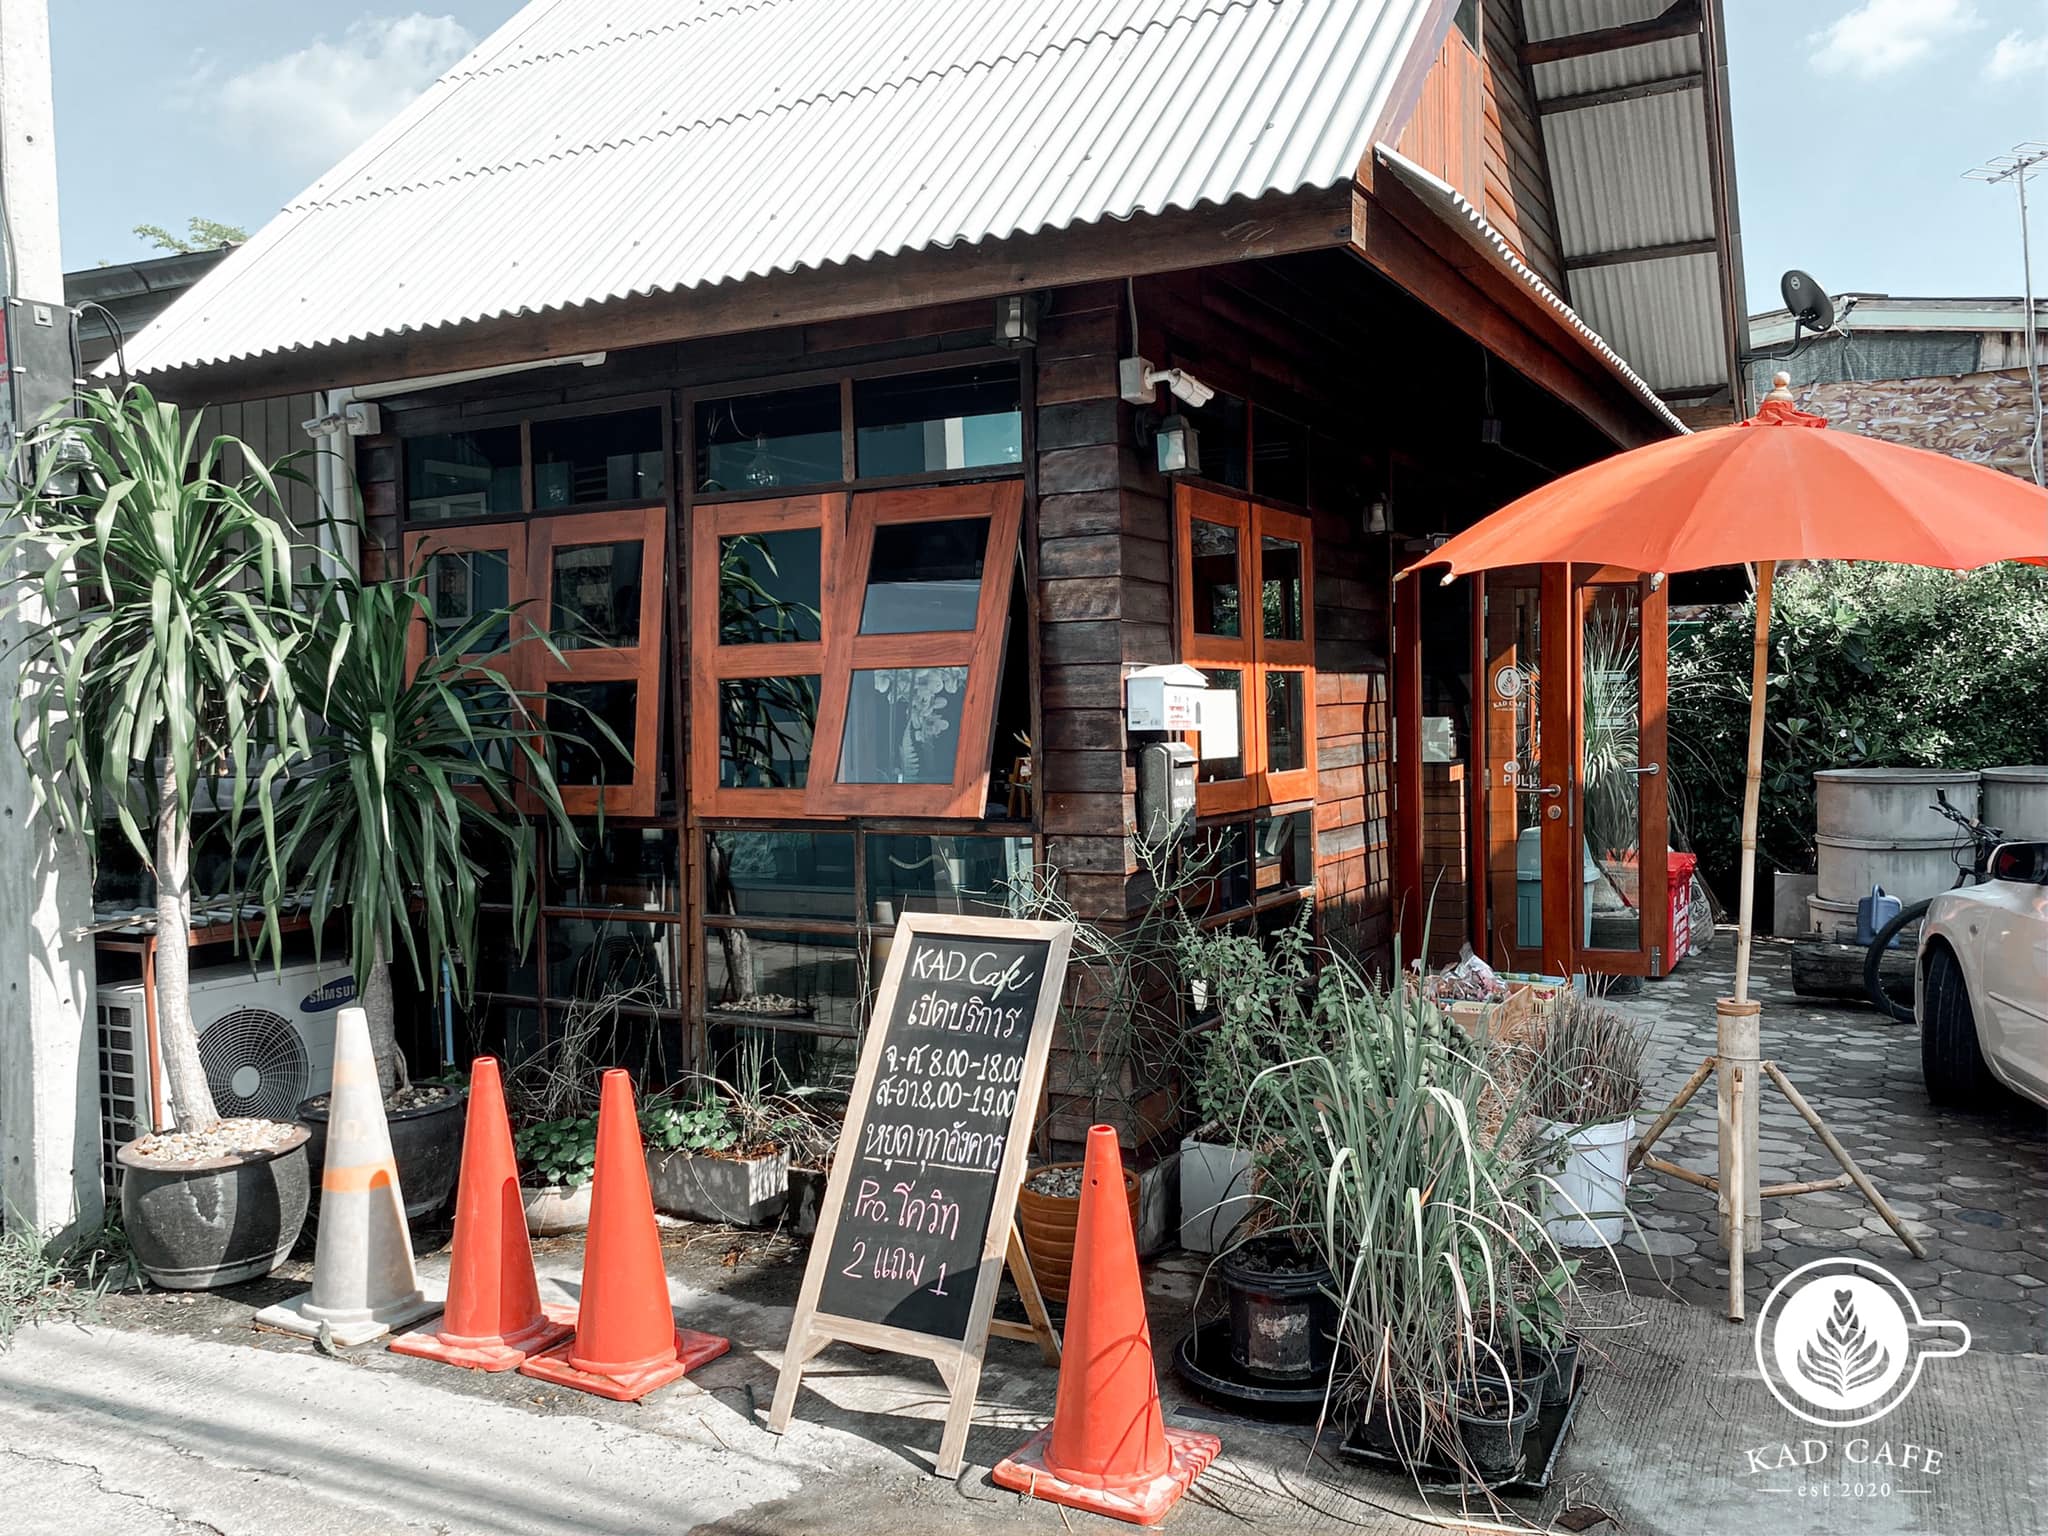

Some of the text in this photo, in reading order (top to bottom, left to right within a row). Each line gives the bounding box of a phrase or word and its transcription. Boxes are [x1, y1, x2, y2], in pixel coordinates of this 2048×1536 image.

[309, 984, 355, 1004] SAMSU
[911, 945, 1035, 1001] KAD Cafe
[907, 990, 1023, 1039] เปิดบริการ
[854, 1179, 889, 1223] Pro.
[842, 1241, 866, 1278] 2
[928, 1262, 948, 1296] 1
